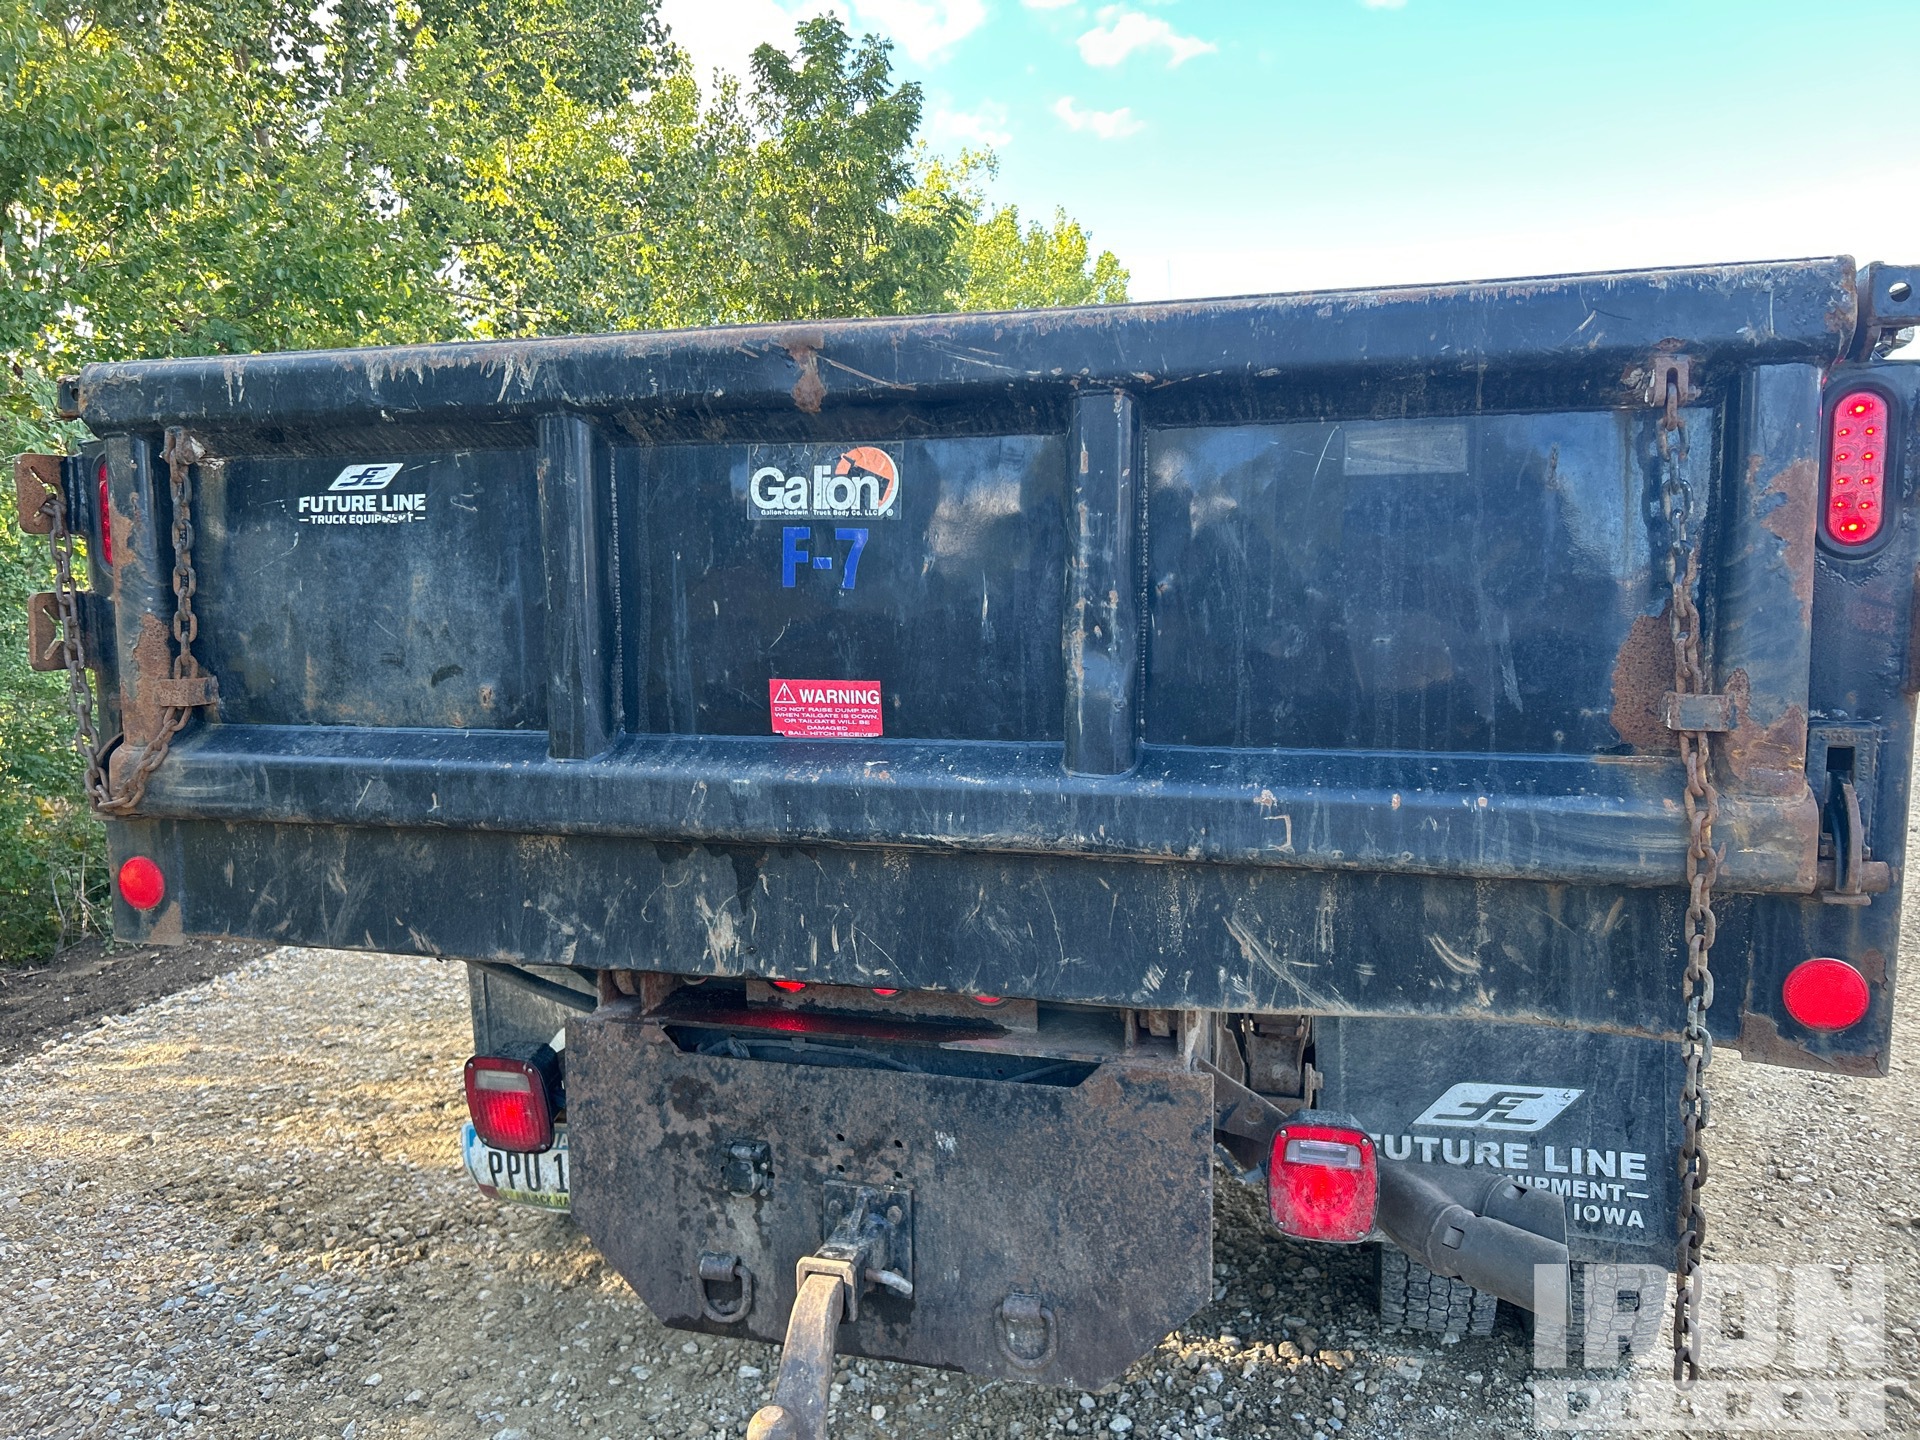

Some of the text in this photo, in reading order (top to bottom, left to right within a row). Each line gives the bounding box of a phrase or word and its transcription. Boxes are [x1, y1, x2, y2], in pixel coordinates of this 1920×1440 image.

[750, 465, 880, 510] Galion
[298, 493, 426, 513] FUTURE LINE
[833, 509, 850, 517] Body
[310, 514, 347, 525] TRUCK
[782, 526, 868, 589] F-7
[799, 688, 880, 705] WARNING
[488, 1151, 569, 1193] PPU 1
[1544, 1145, 1647, 1181] LINE
[1507, 1174, 1625, 1202] IPMENT
[1573, 1203, 1645, 1229] IOWA
